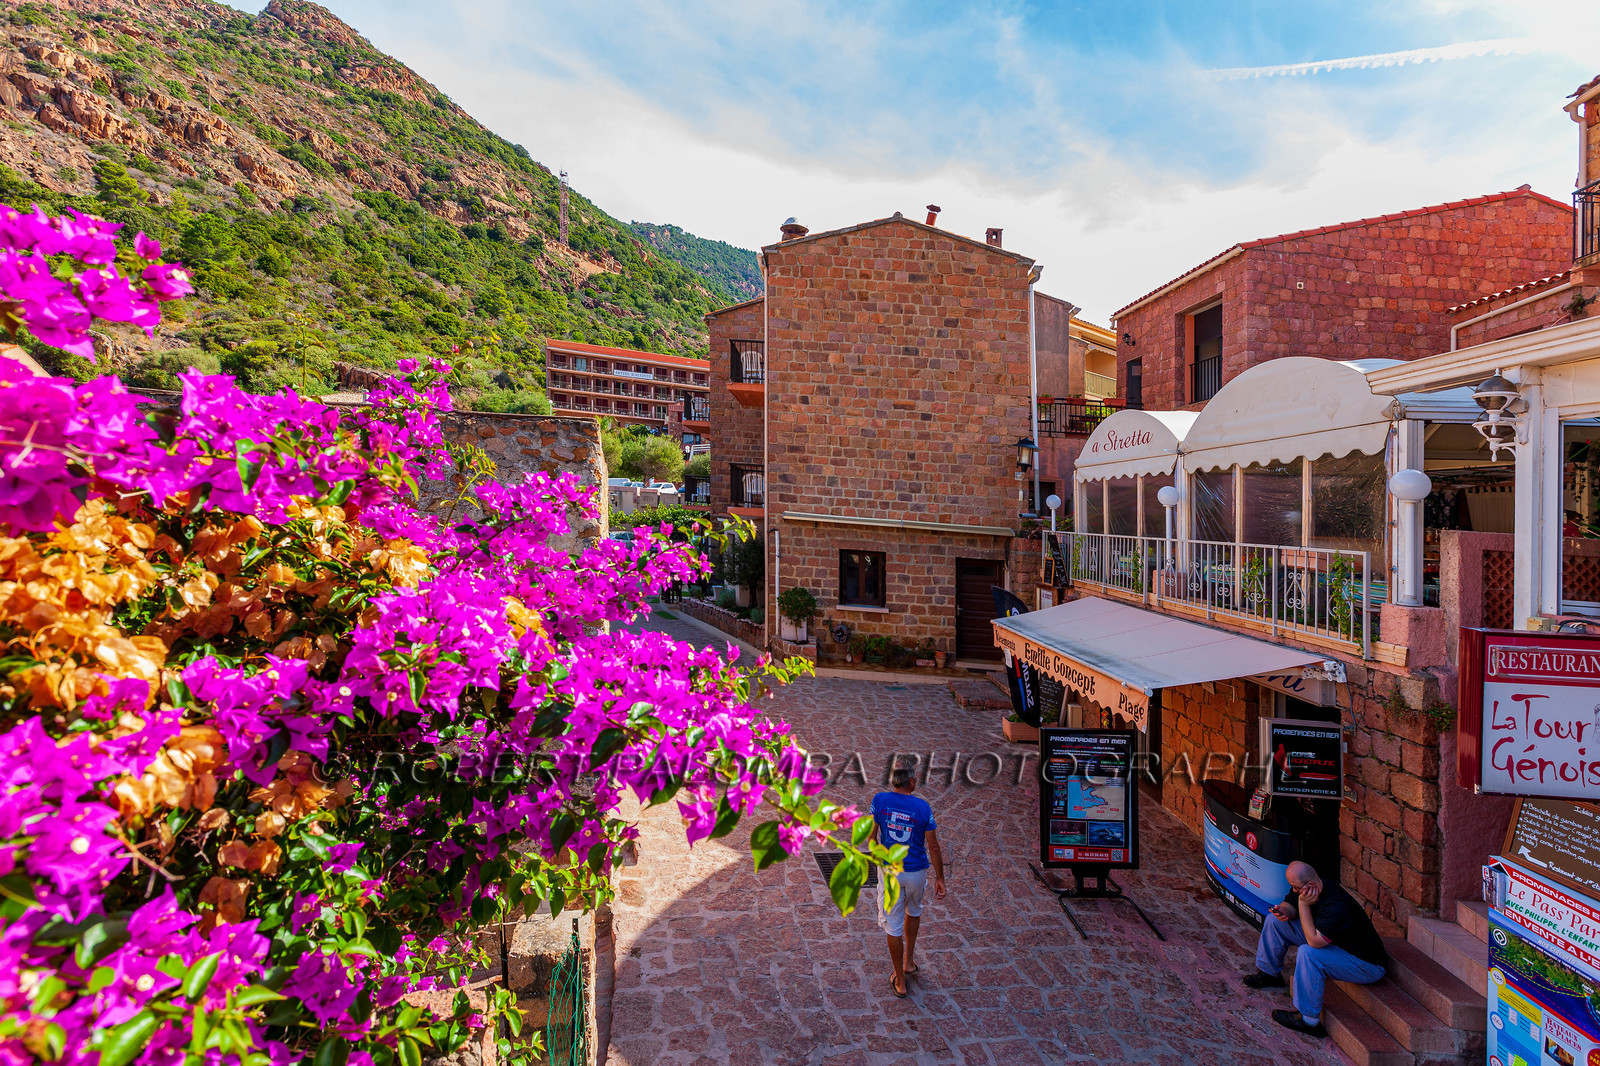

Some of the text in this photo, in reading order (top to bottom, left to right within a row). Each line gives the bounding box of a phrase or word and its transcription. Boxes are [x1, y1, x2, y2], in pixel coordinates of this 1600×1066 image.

[1091, 429, 1155, 453] a Stretta
[1025, 642, 1051, 671] Emilie
[1053, 655, 1096, 697] Concept
[1118, 692, 1145, 722] Plage
[1492, 694, 1591, 742] La Tour
[1508, 880, 1526, 900] Le
[1512, 871, 1591, 916] PROMENADES
[1505, 900, 1524, 913] AVEC
[1561, 928, 1600, 951] L'ENFANT
[1505, 909, 1522, 924] EN
[1523, 920, 1566, 949] VENTE
[1546, 1017, 1578, 1042] BATEAUX
[1556, 1029, 1582, 1051] PLACES
